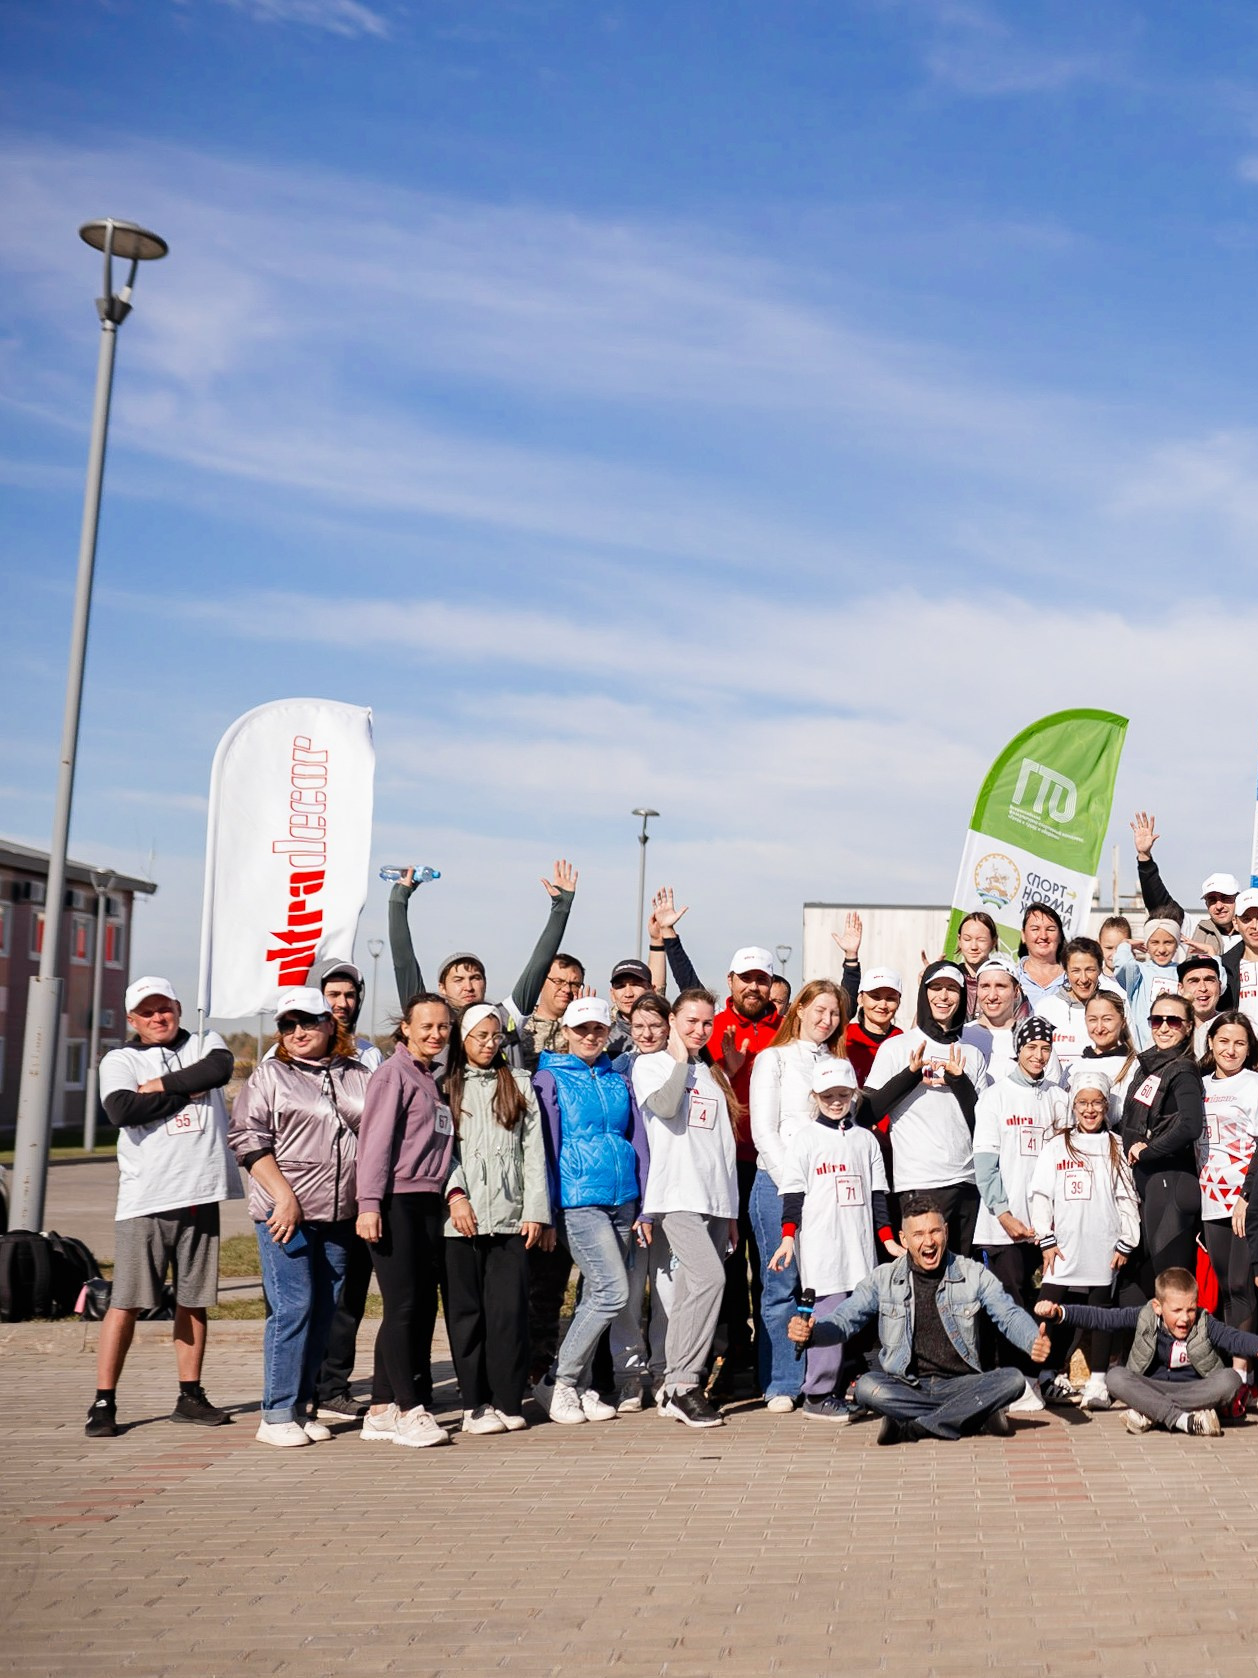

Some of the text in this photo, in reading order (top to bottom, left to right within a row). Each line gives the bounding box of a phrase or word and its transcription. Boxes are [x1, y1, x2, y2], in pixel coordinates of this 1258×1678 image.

[1026, 872, 1067, 898] СПОРТ
[1022, 886, 1074, 917] НОРМА
[1140, 1084, 1153, 1099] 60
[175, 1113, 191, 1129] 55
[699, 1109, 707, 1123] 4
[1006, 1114, 1034, 1126] ultra
[1027, 1137, 1037, 1151] 41
[816, 1161, 847, 1176] ultra
[845, 1186, 857, 1201] 71
[1071, 1181, 1084, 1195] 39
